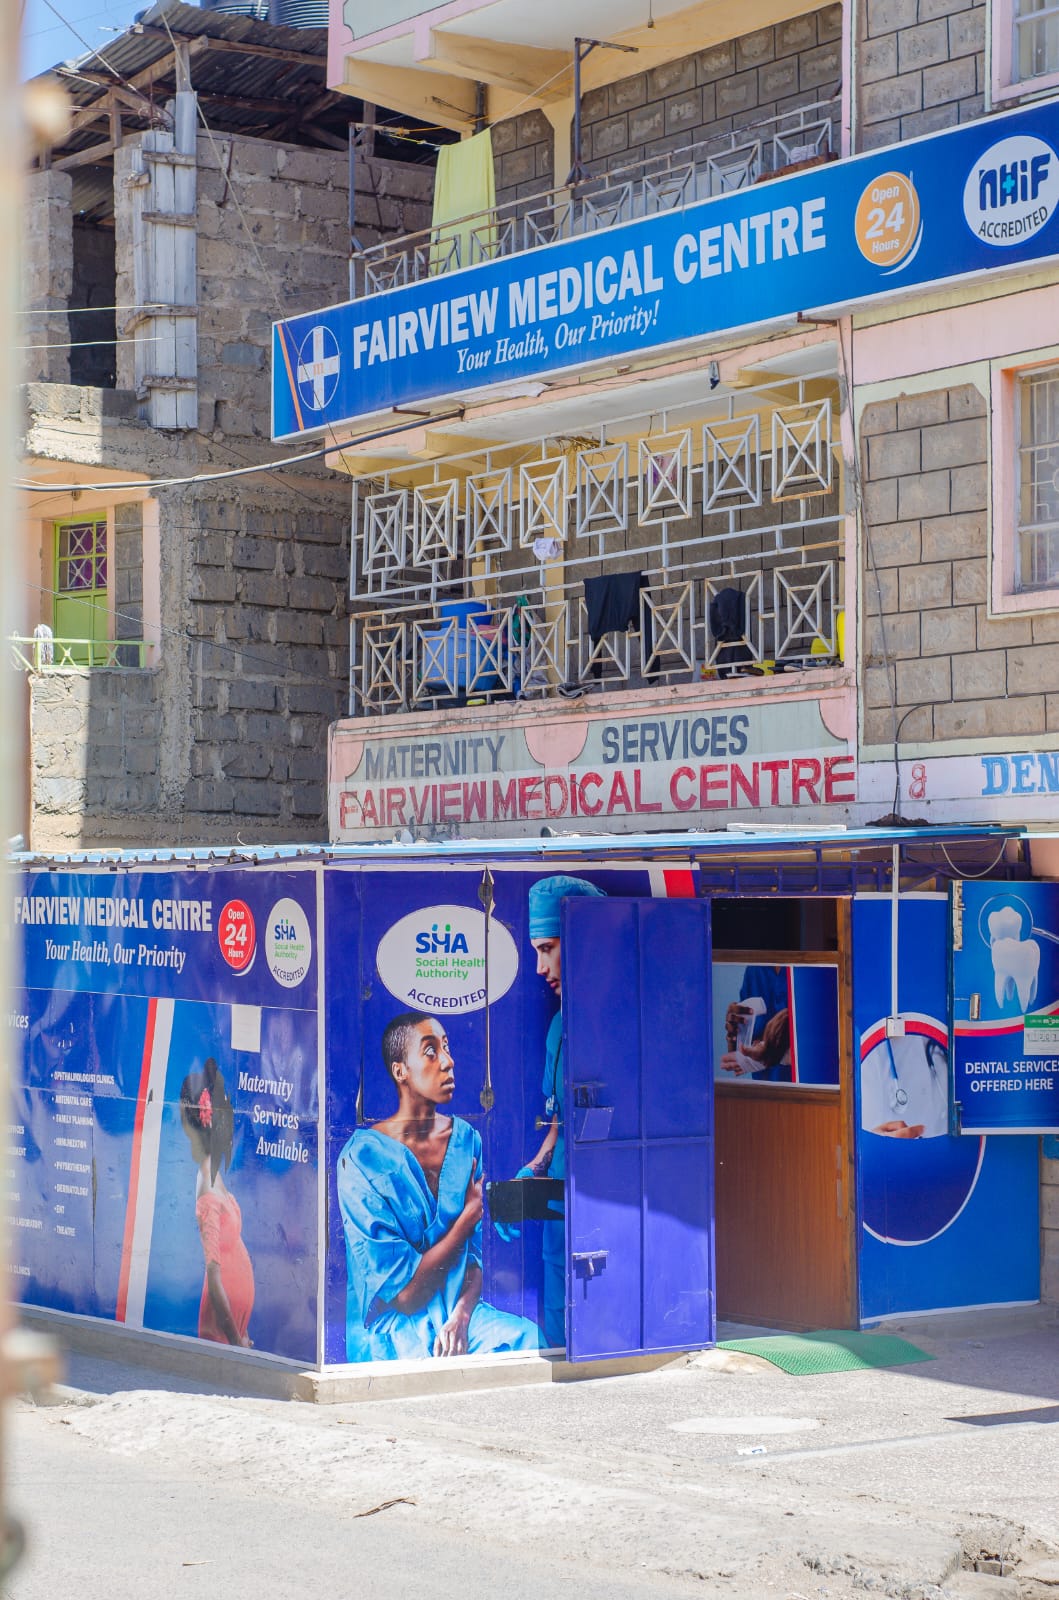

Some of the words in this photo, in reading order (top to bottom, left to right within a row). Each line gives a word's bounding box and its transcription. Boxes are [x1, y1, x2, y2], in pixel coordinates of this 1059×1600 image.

[871, 184, 900, 205] Open
[865, 202, 905, 239] 24
[978, 206, 1048, 238] ACCREDITED
[872, 238, 900, 254] Hours
[353, 287, 499, 370] FAIRVIEW
[508, 245, 663, 328] MEDICAL
[673, 197, 826, 285] CENTRE
[457, 348, 491, 374] Your
[494, 331, 549, 361] Health,
[554, 323, 587, 350] Our
[589, 301, 660, 344] Priority!
[365, 735, 506, 780] MATERNITY
[601, 714, 748, 764] SERVICES
[339, 781, 487, 829] FAIRVIEW
[492, 769, 662, 822] MEDICAL
[669, 756, 855, 812] CENTRE
[14, 896, 81, 925] FAIRVIEW
[83, 897, 149, 929] MEDICAL
[152, 900, 213, 932] CENTRE
[228, 908, 245, 922] Open
[224, 923, 248, 946] 24
[274, 919, 297, 940] SHA
[416, 923, 469, 954] SHA
[44, 939, 71, 960] Your
[72, 940, 111, 966] Health,
[113, 944, 136, 964] Our
[138, 945, 186, 974] Priority
[228, 948, 244, 958] Hours
[416, 957, 448, 967] Social
[273, 965, 305, 981] ACCREDITED
[416, 968, 469, 981] Authority
[407, 988, 487, 1008] ACCREDITED
[965, 1061, 1010, 1075] DENTAL
[1013, 1060, 1059, 1073] SERVICE
[238, 1071, 293, 1102] Maternity
[970, 1079, 1023, 1092] OFFERED
[1025, 1078, 1054, 1091] HERE
[253, 1104, 300, 1130] Services
[256, 1135, 309, 1164] Available
